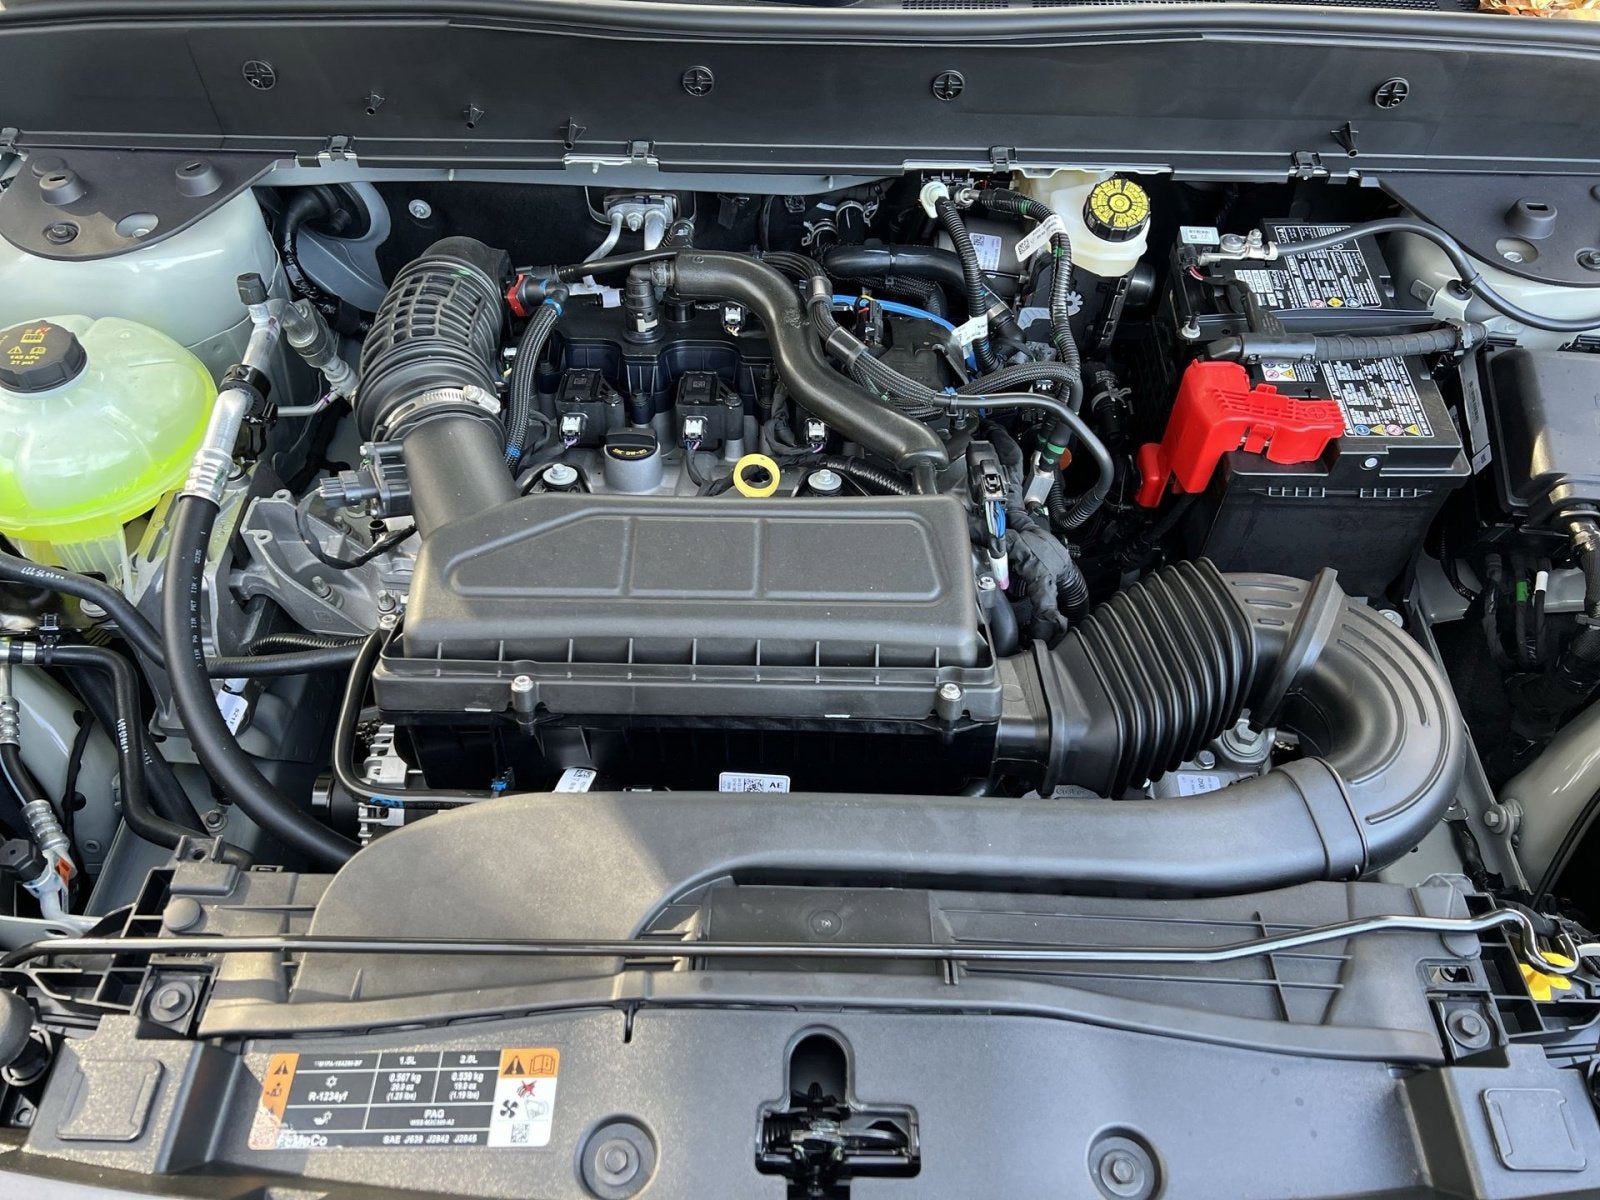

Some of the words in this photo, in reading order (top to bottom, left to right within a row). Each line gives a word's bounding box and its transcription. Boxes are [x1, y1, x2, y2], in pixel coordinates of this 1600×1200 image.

[399, 1056, 416, 1065] 1.5L
[459, 1055, 478, 1064] 2.0L
[411, 1072, 422, 1084] kg
[473, 1072, 484, 1083] kg
[308, 1091, 349, 1103] R-1234yf
[423, 1109, 445, 1119] PAG
[382, 1135, 401, 1145] SAE
